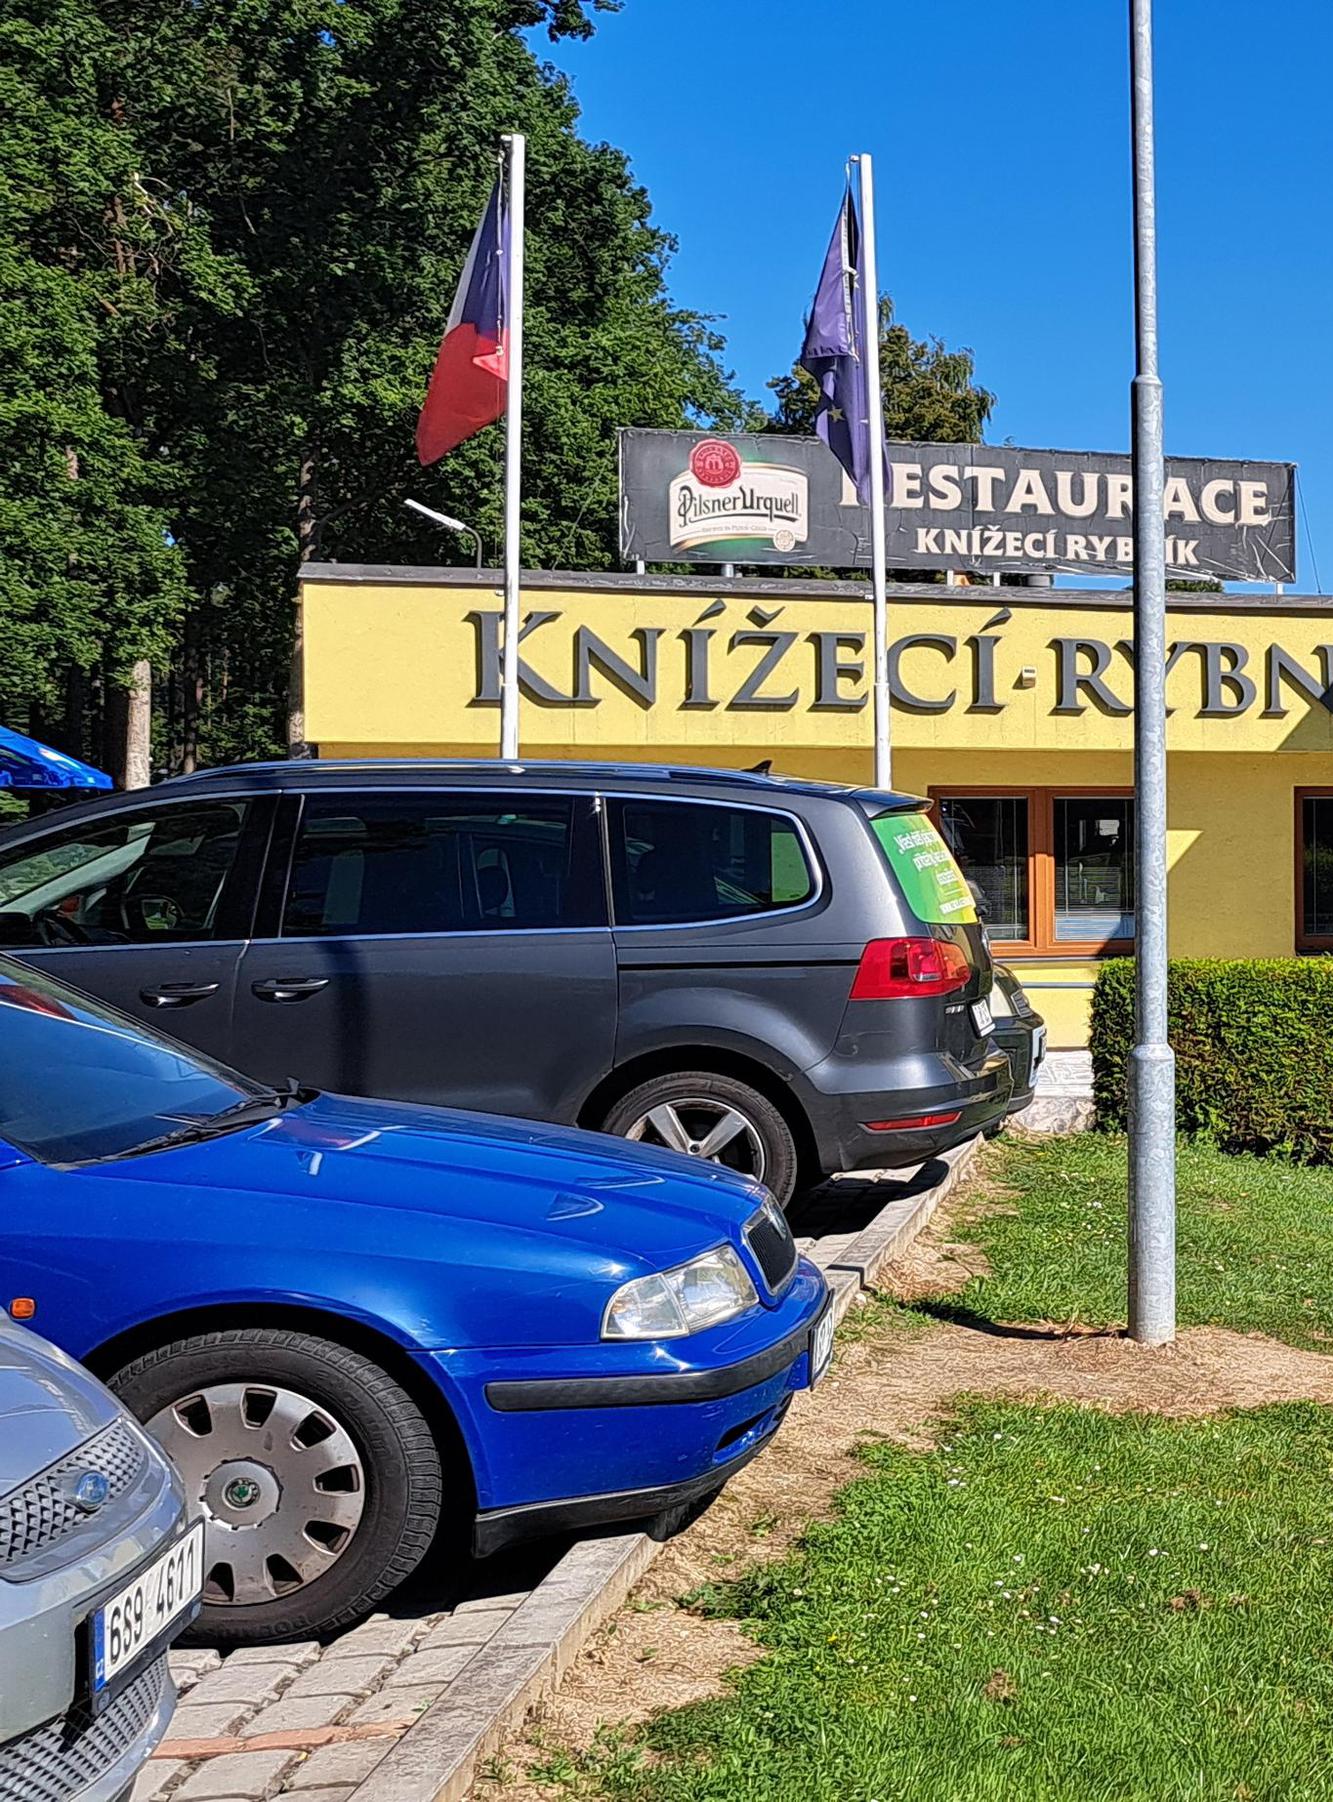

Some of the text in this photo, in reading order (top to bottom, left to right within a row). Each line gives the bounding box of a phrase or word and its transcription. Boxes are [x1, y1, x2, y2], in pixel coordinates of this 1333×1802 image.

[916, 524, 1200, 566] KNÍŽECÍ RYBÍK
[462, 598, 1013, 717] KNÍŽECÍ
[109, 1585, 144, 1666] 6S9
[155, 1537, 194, 1619] 4611
